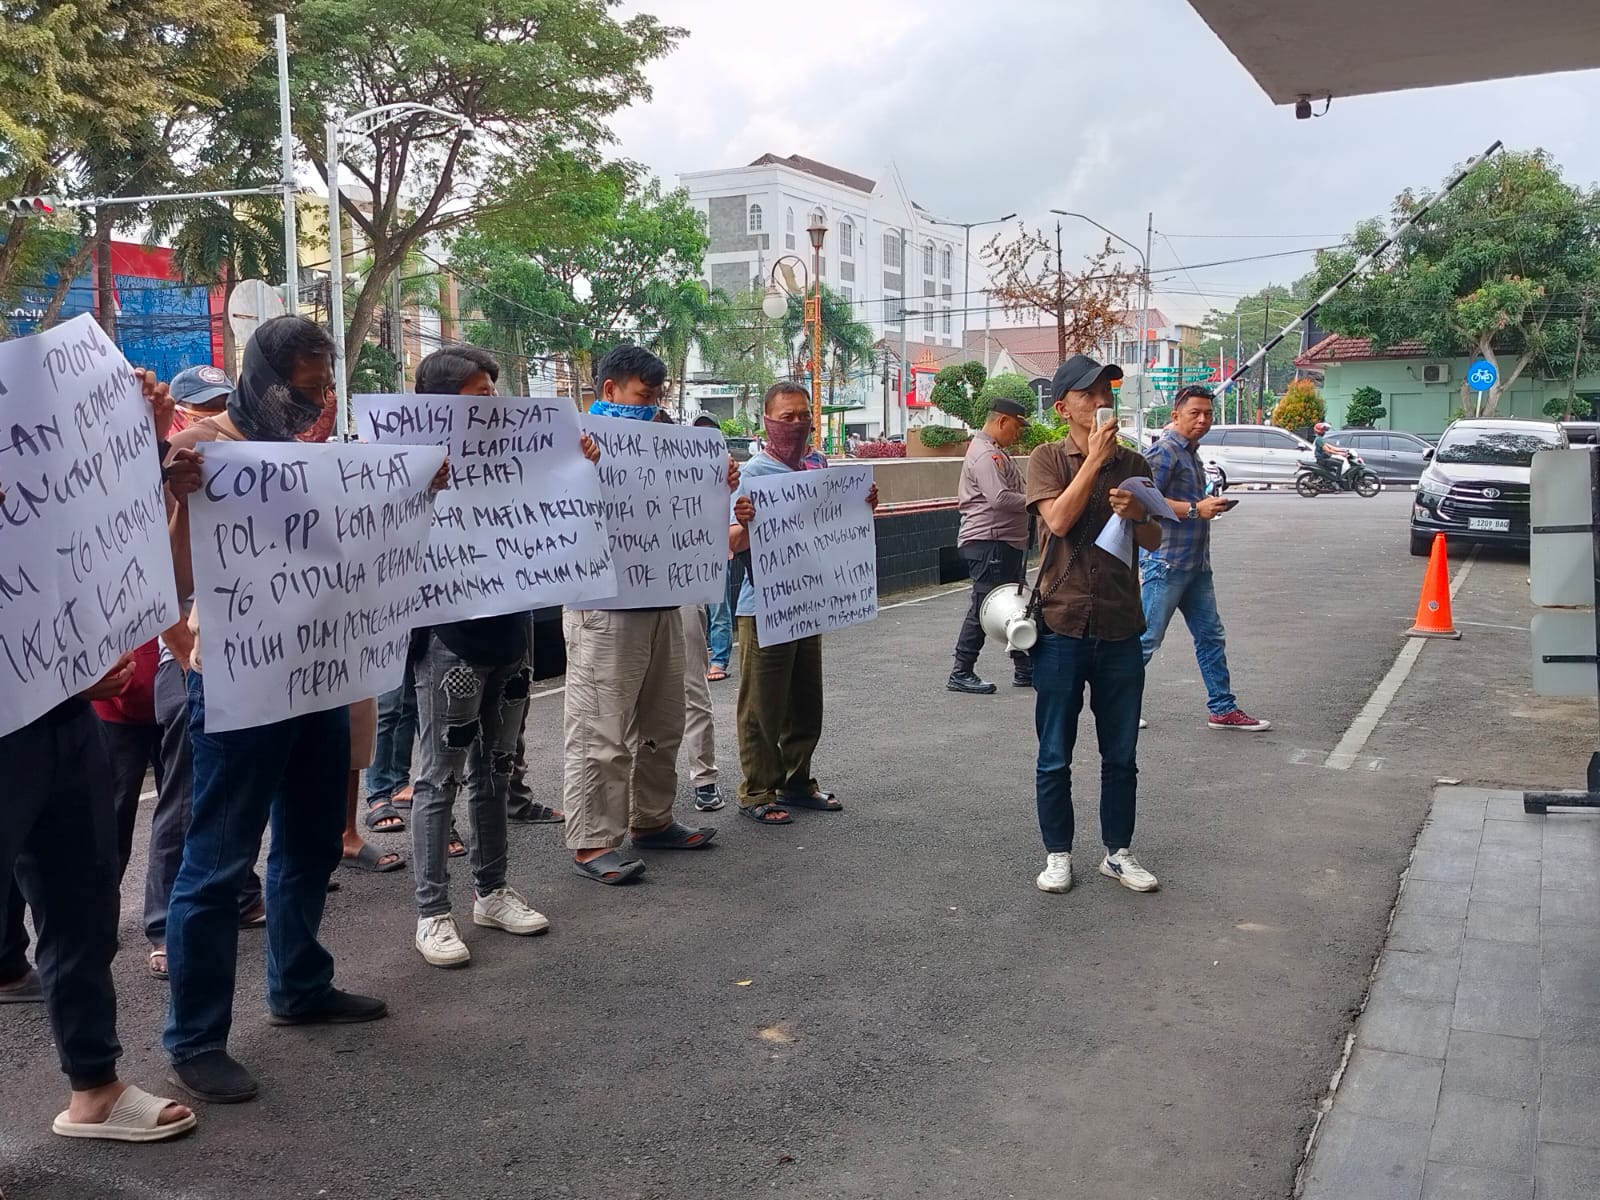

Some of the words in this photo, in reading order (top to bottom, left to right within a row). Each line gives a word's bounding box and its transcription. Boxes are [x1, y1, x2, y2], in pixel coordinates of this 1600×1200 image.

[467, 404, 559, 430] RAKYAT
[0, 452, 107, 527] ENUTUP
[103, 415, 152, 483] JALAN
[205, 459, 308, 503] COPOT
[338, 452, 410, 493] KASAT
[449, 456, 523, 490] KRAPK)
[598, 465, 627, 488] UKO
[634, 466, 656, 490] 30
[670, 494, 702, 521] RTH
[750, 489, 779, 508] PAK
[822, 473, 866, 502] JANGAN
[335, 504, 376, 540] KOTA
[754, 513, 804, 548] TEBANG
[496, 530, 577, 560] DUGAAN
[607, 527, 660, 553] DIDUGA
[624, 564, 659, 588] TDK
[758, 541, 810, 576] DALAM
[97, 556, 147, 626] KOTA
[271, 562, 366, 605] DIDUGA
[515, 562, 573, 591] OKNUM
[224, 620, 284, 682] PILIH
[297, 618, 338, 654] DLM
[287, 658, 348, 709] PERDA
